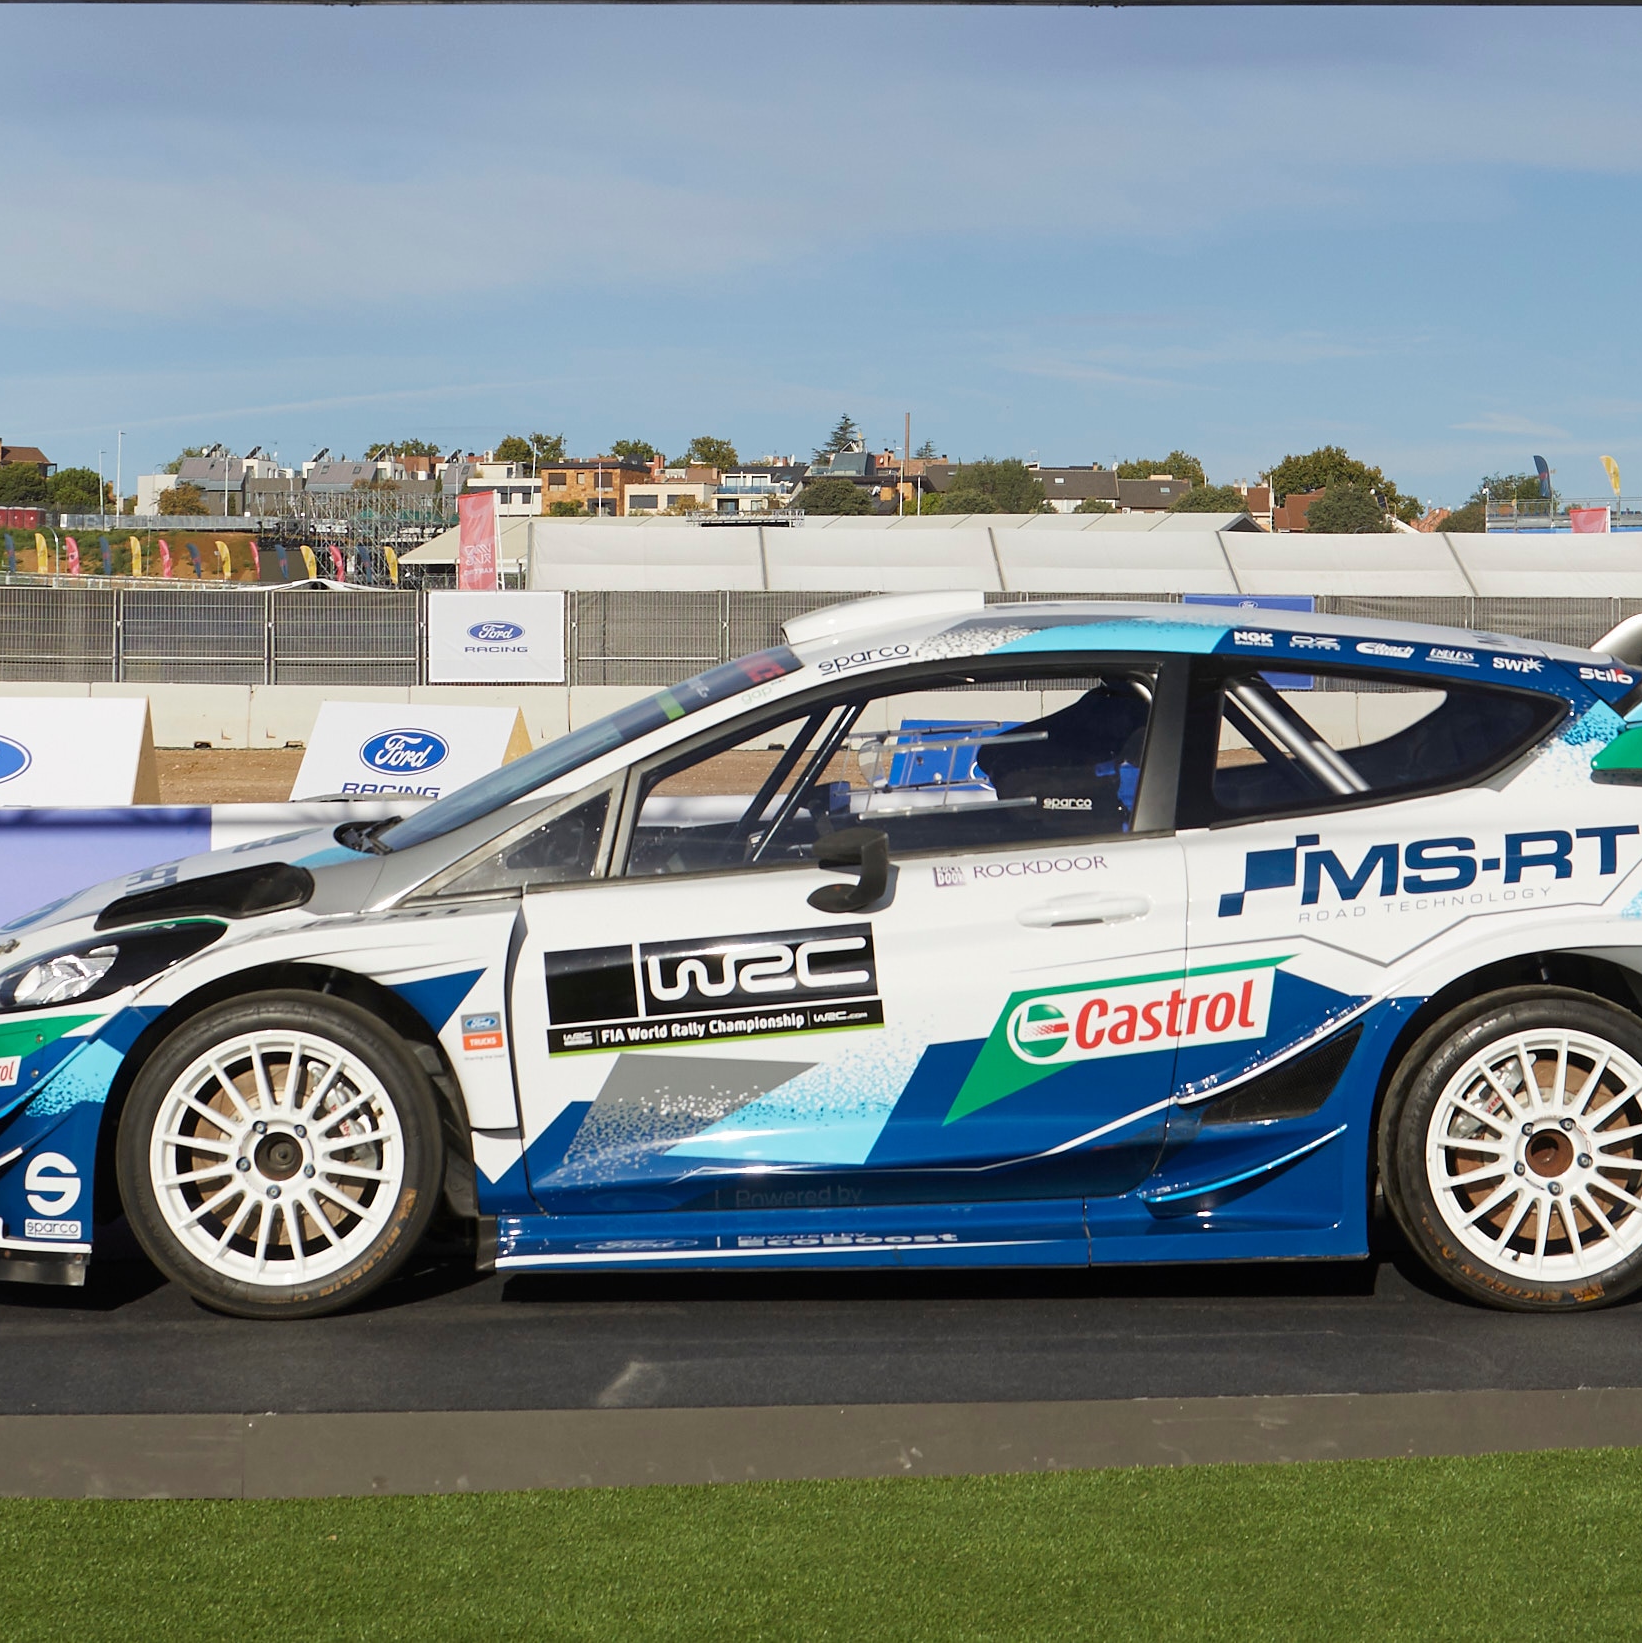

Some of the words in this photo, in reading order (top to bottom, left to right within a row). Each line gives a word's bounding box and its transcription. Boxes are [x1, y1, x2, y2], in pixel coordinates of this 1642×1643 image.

[478, 623, 514, 639] Ford
[1234, 631, 1274, 643] NGK
[818, 644, 910, 673] sparco
[1430, 647, 1475, 660] ENDLESS
[1579, 667, 1634, 684] Stilo
[374, 734, 434, 767] Ford
[341, 782, 441, 798] RACING
[1043, 798, 1093, 808] sparco
[973, 855, 1109, 879] ROCKDOOR
[1300, 824, 1640, 906] MS-RT
[1298, 906, 1367, 924] ROAD
[1383, 886, 1554, 914] TECHNOLOGY
[647, 936, 871, 1001] WRC
[1075, 979, 1256, 1050] Castrol
[601, 1028, 625, 1043] FIA
[627, 1024, 668, 1042] World
[671, 1021, 706, 1038] Rally
[709, 1013, 806, 1034] Championship
[469, 1036, 497, 1047] TRUCKS
[26, 1221, 79, 1236] sparco
[737, 1234, 958, 1247] EcoBoost
